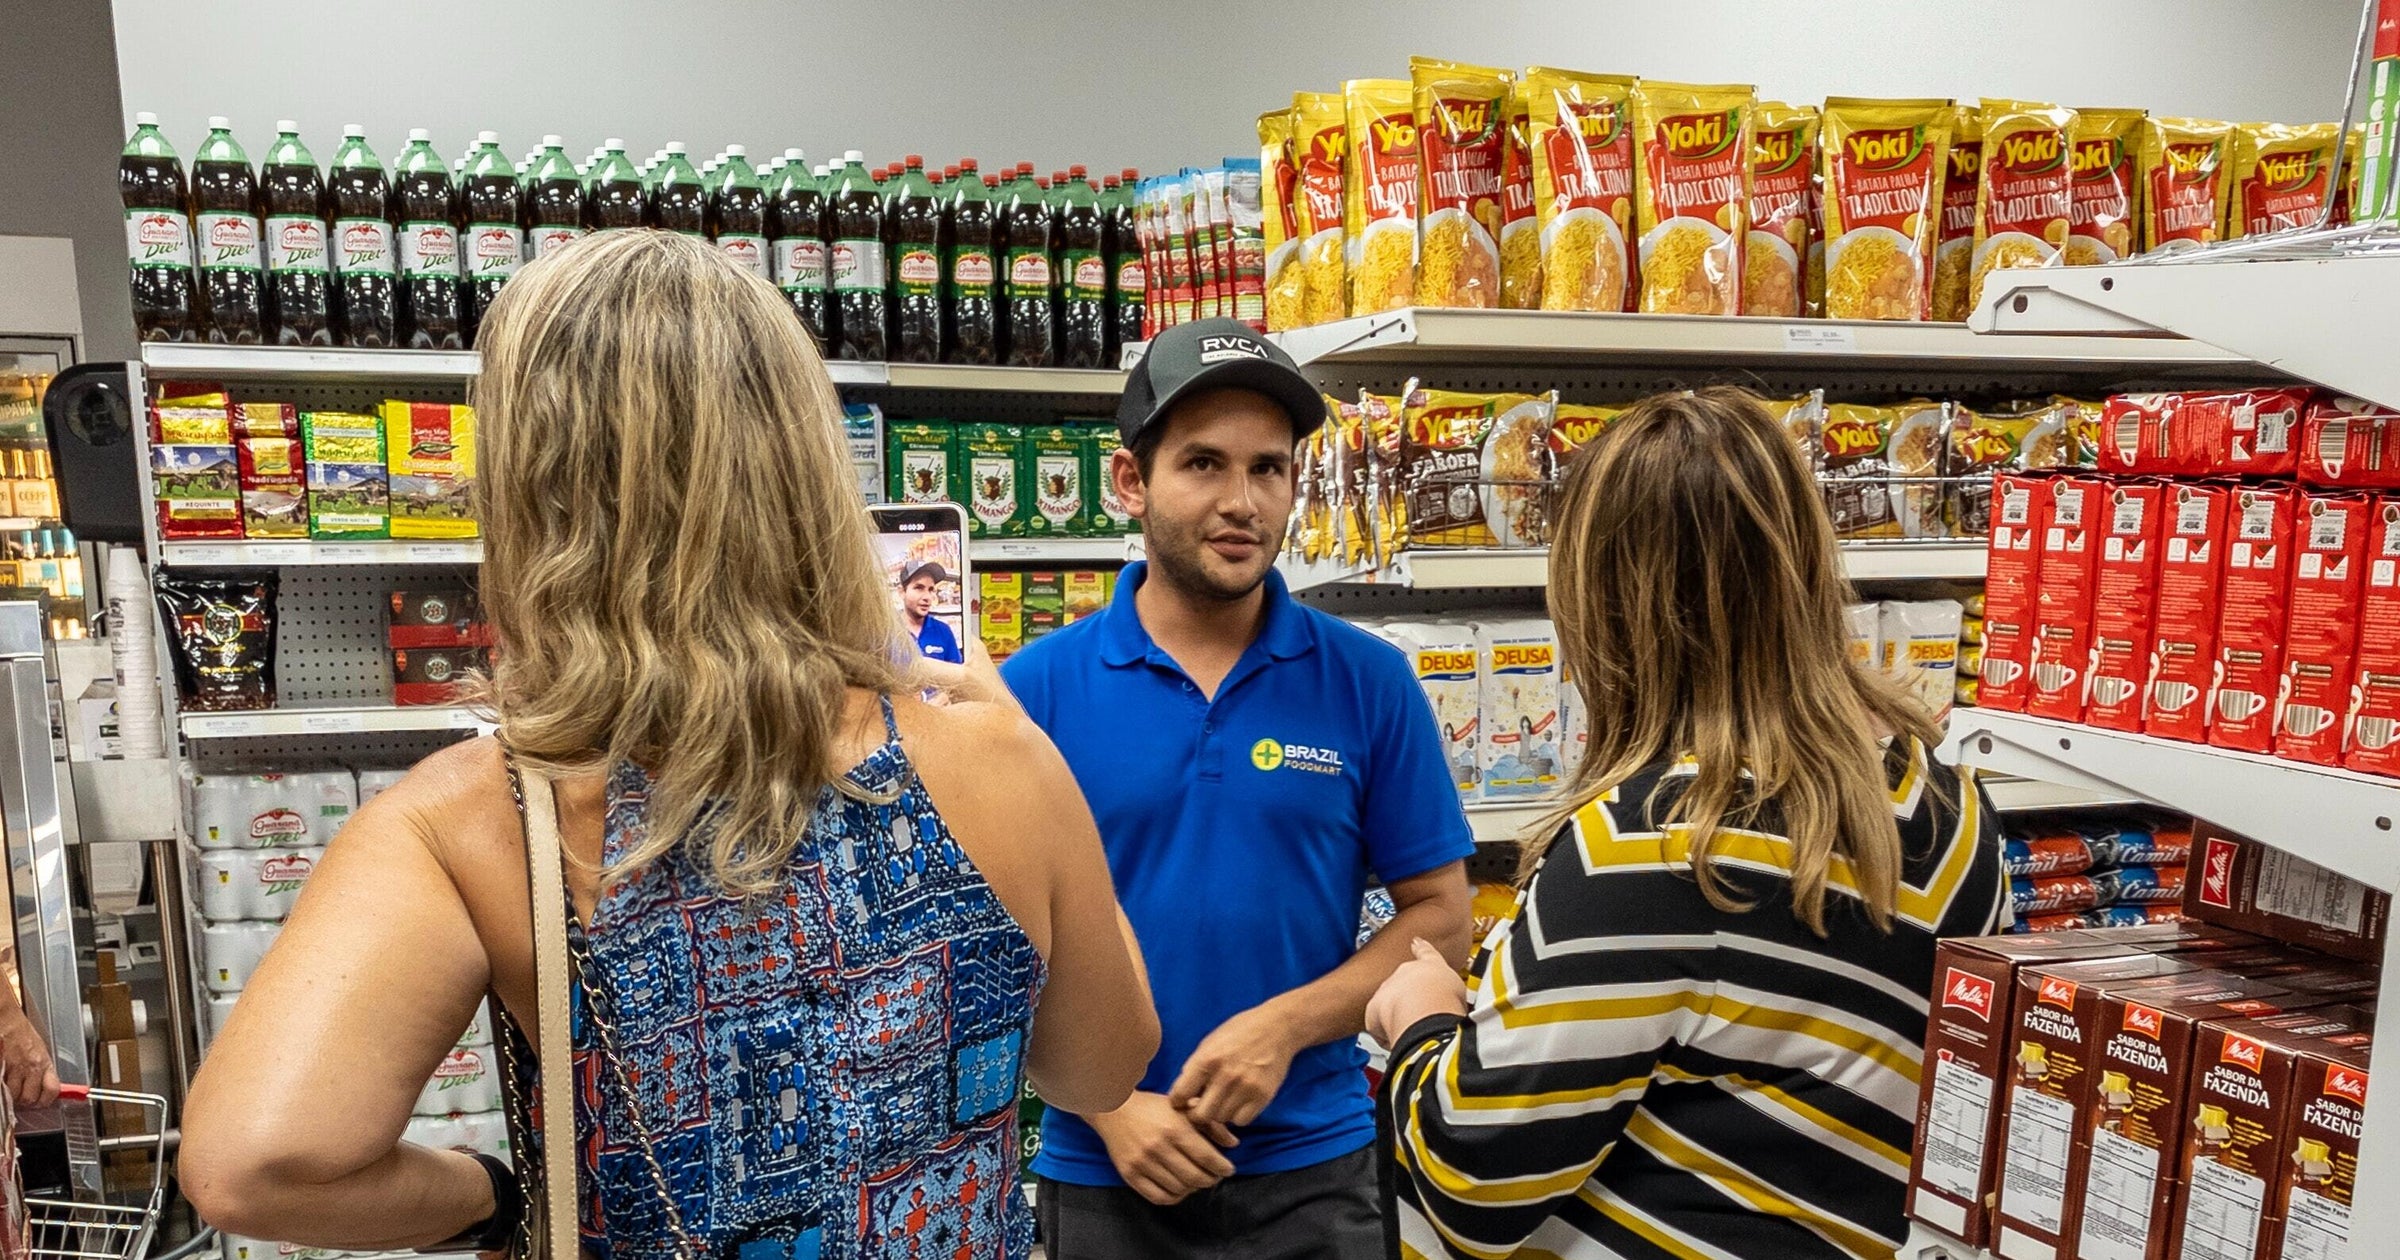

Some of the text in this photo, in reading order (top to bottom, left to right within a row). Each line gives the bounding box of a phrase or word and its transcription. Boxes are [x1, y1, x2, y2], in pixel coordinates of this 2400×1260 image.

[1577, 108, 1610, 137] oki
[1373, 121, 1416, 152] Yo
[1660, 116, 1722, 152] Yoki
[1317, 132, 1345, 162] Yo
[1848, 131, 1908, 165] Yoki
[2004, 130, 2060, 168] Yoki
[2072, 142, 2110, 172] oki
[1671, 159, 1733, 180] BATATA PALHA
[1950, 149, 1978, 177] Yo
[2259, 154, 2307, 187] Yoki
[1857, 172, 1919, 192] BATATA PALHA
[2003, 180, 2036, 197] BATATA
[1846, 186, 1924, 219] TRADICION
[144, 241, 182, 259] Diet
[216, 244, 253, 261] Diet
[286, 247, 323, 264] Diet
[348, 249, 385, 266] Diet
[482, 254, 516, 271] Diet
[1202, 336, 1269, 359] RVCA
[0, 400, 34, 418] IPAVA
[1828, 425, 1880, 454] Yoki
[1411, 452, 1480, 477] FAROFA
[973, 499, 1018, 518] XIMANGO
[1038, 498, 1081, 515] XIMANGO
[1102, 496, 1126, 514] XIMA
[1420, 654, 1475, 672] DEUSA
[1494, 647, 1552, 666] DEUSA
[1284, 744, 1343, 765] BRAZIL
[1284, 759, 1342, 776] FOODMART
[2009, 855, 2060, 875] amil
[2120, 845, 2181, 863] Camil
[2206, 850, 2229, 900] Melitta
[265, 880, 305, 897] Die
[2122, 880, 2184, 899] Camil
[2014, 894, 2062, 913] amil
[1949, 977, 1985, 1008] Melitta
[2043, 981, 2072, 1003] Melitta
[2032, 1005, 2075, 1026] SABOR DA
[2127, 1009, 2159, 1032] Melitta
[2024, 1012, 2082, 1044] FAZENDA
[2116, 1034, 2162, 1056] SABOR DA
[2226, 1040, 2260, 1064] Melitta
[2107, 1040, 2169, 1075] FAZENDA
[438, 1072, 480, 1091] Diet
[2214, 1066, 2263, 1090] SABOR DA
[2329, 1072, 2364, 1098] Melitta
[2203, 1072, 2271, 1109] FAZENDA
[2315, 1097, 2351, 1118] SABOR
[2303, 1104, 2363, 1139] FAZEND
